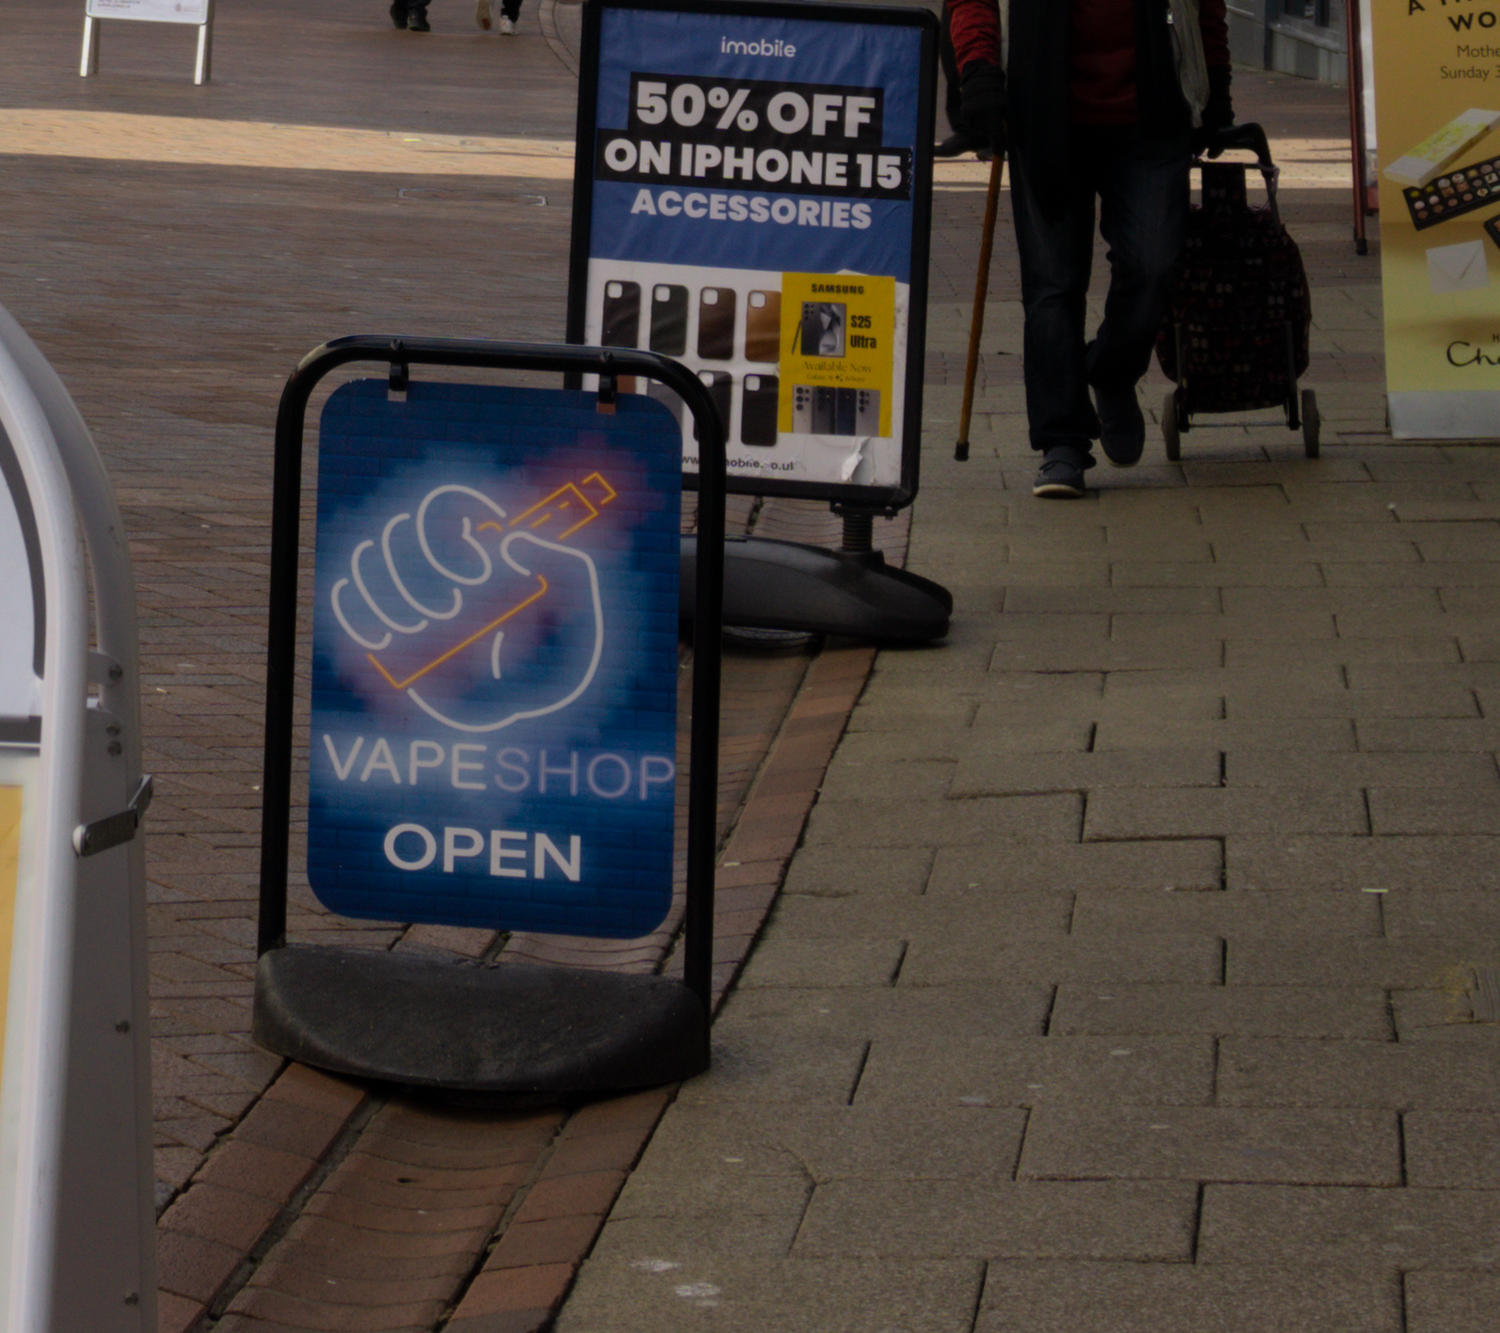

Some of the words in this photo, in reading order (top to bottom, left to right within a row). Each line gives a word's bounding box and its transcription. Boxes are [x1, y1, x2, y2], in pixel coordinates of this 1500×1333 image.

[721, 36, 796, 60] imobile
[1440, 64, 1490, 82] Sunday
[636, 81, 758, 132] 50%
[767, 92, 876, 139] OFF
[604, 138, 670, 176] ON
[681, 142, 847, 188] IPHONE
[856, 153, 902, 190] 15
[631, 189, 872, 230] ACCESSORIES
[811, 283, 865, 295] SAMSUNG
[850, 315, 872, 329] S25
[849, 334, 877, 349] Ultra
[802, 360, 847, 373] Available
[849, 362, 873, 374] Now
[384, 822, 583, 883] OPEN
